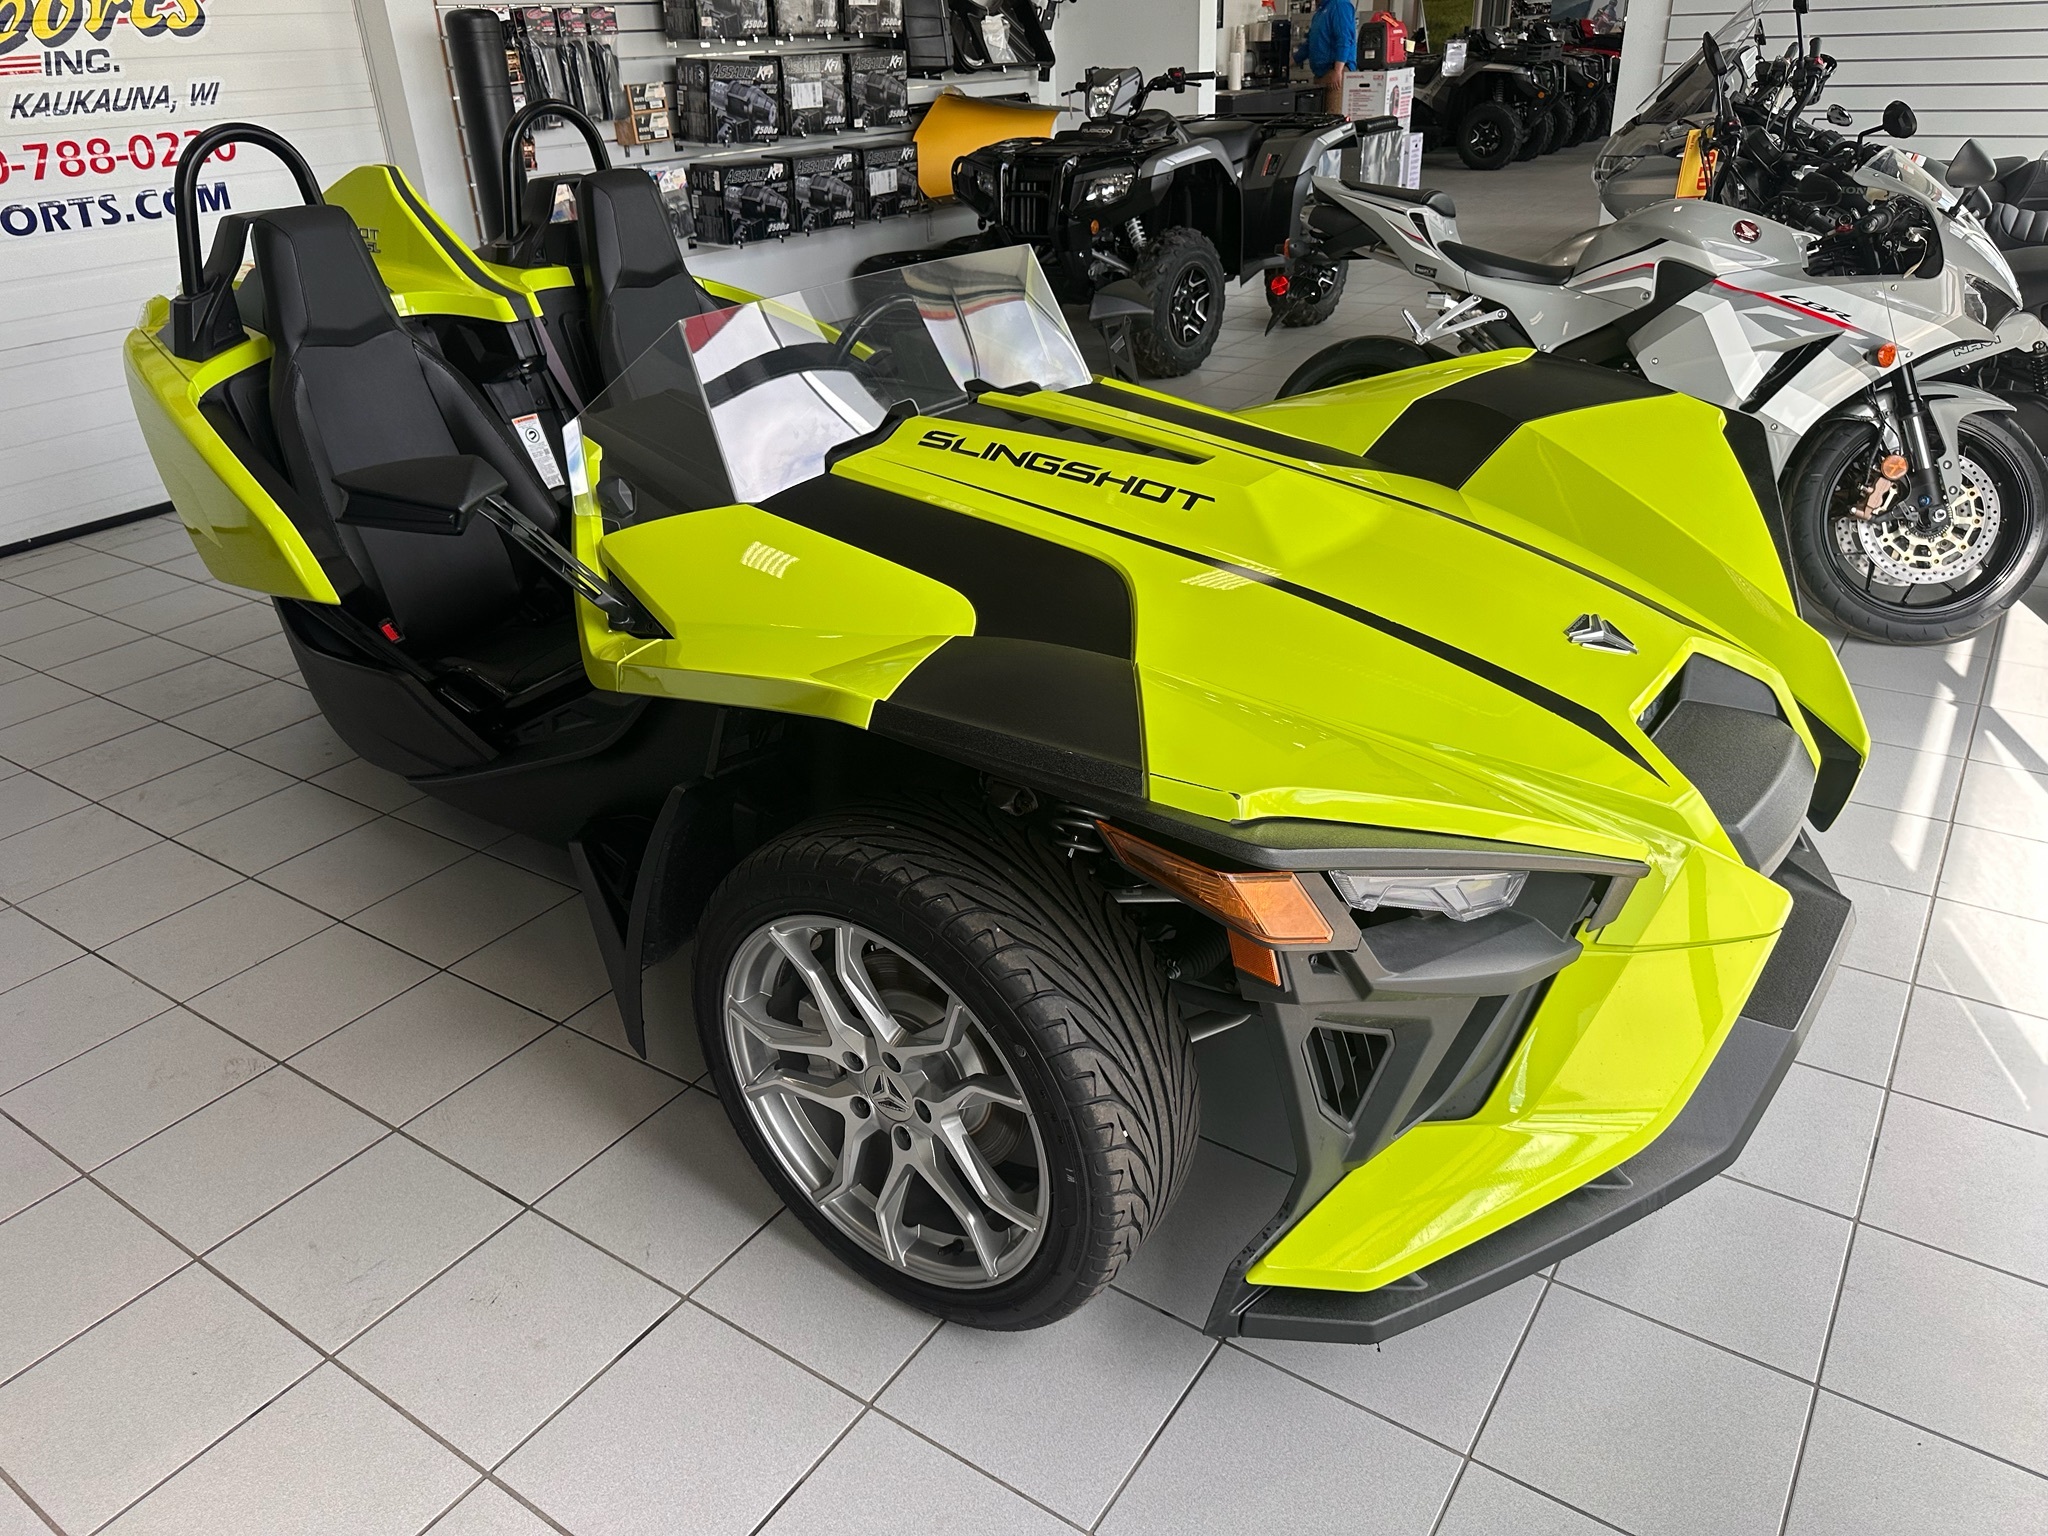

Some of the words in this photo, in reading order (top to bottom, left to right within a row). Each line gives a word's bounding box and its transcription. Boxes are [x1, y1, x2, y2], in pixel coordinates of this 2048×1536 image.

[44, 48, 120, 77] INC.
[711, 63, 757, 79] ASSAULT
[10, 85, 178, 120] KAUKAUNA,
[190, 81, 221, 108] WI
[724, 168, 768, 185] ASSAULT
[917, 430, 1216, 511] SLINGSHOT
